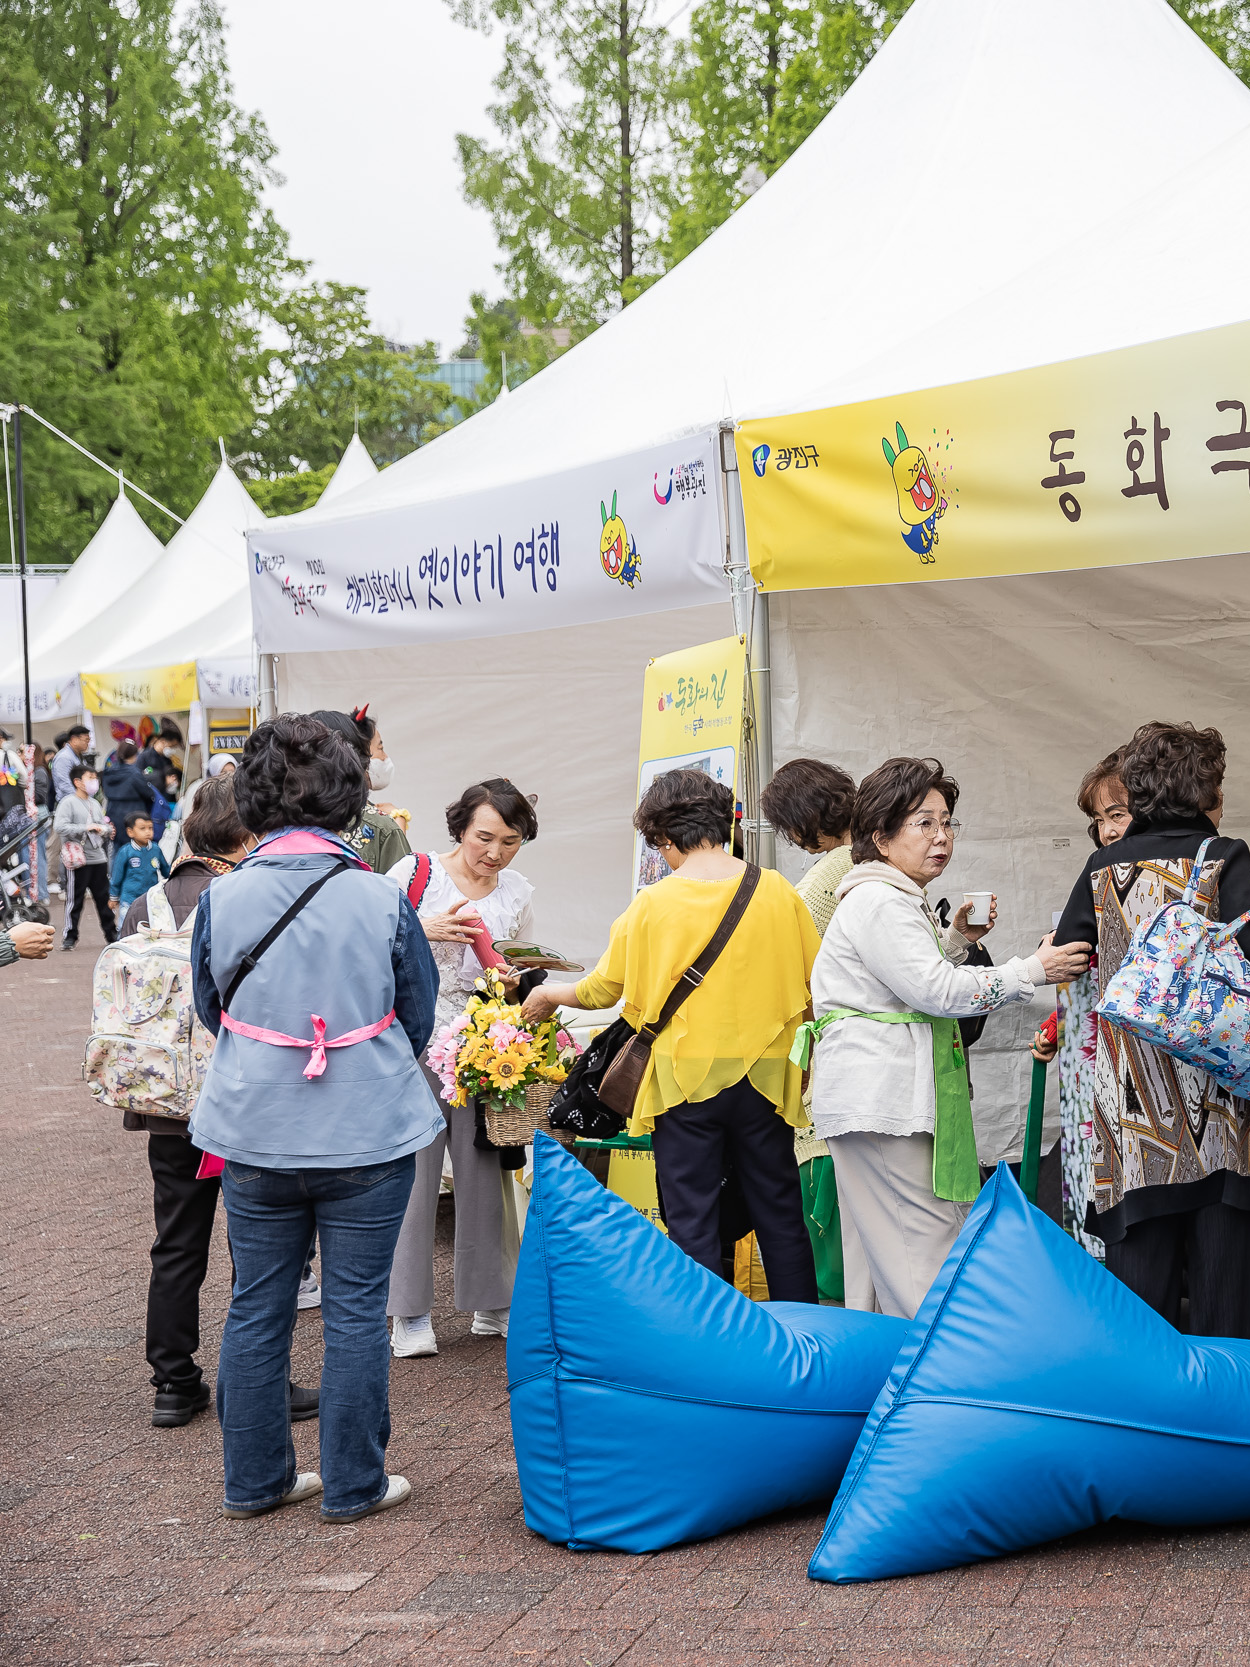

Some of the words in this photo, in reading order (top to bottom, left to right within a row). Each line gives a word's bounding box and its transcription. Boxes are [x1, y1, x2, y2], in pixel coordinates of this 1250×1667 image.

[775, 442, 821, 472] 광진구
[345, 565, 417, 615] 해피할머니
[418, 534, 504, 611] 옛이야기
[513, 520, 560, 595] 여행
[710, 669, 728, 709] 집
